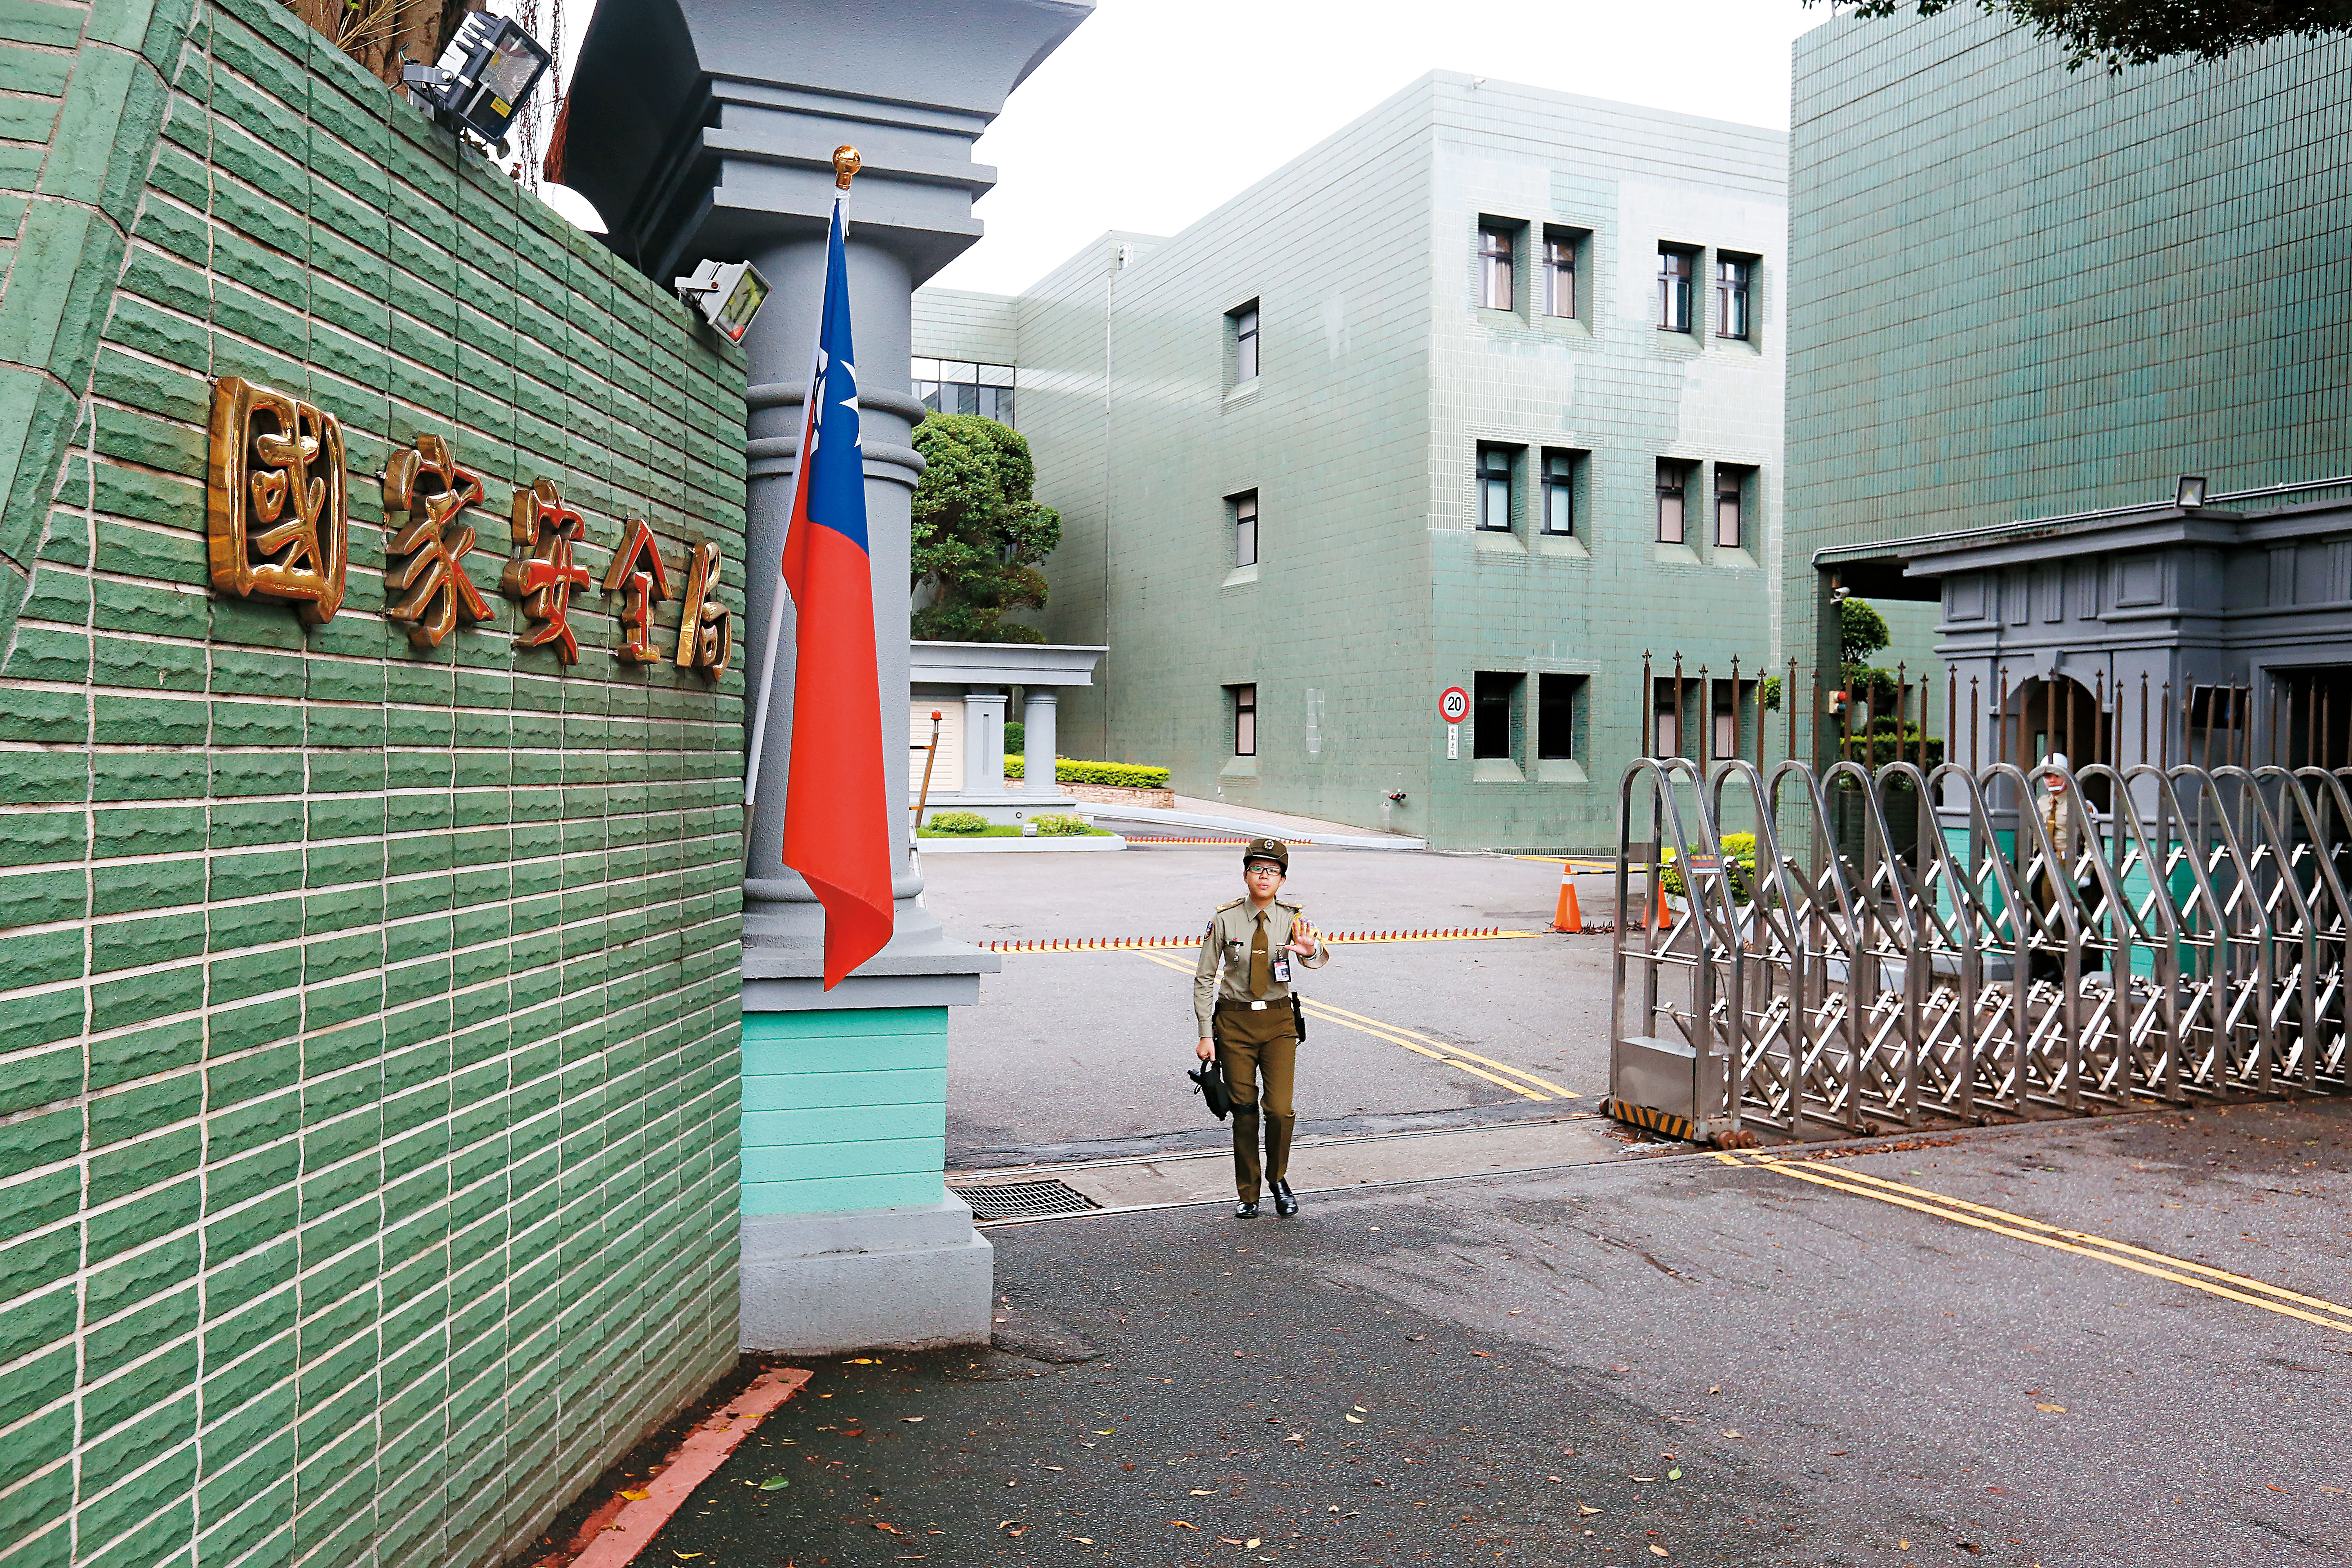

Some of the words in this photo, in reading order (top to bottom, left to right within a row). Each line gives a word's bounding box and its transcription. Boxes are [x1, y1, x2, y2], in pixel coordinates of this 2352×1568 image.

[208, 376, 732, 682] 國家安全局
[1448, 696, 1461, 711] 20
